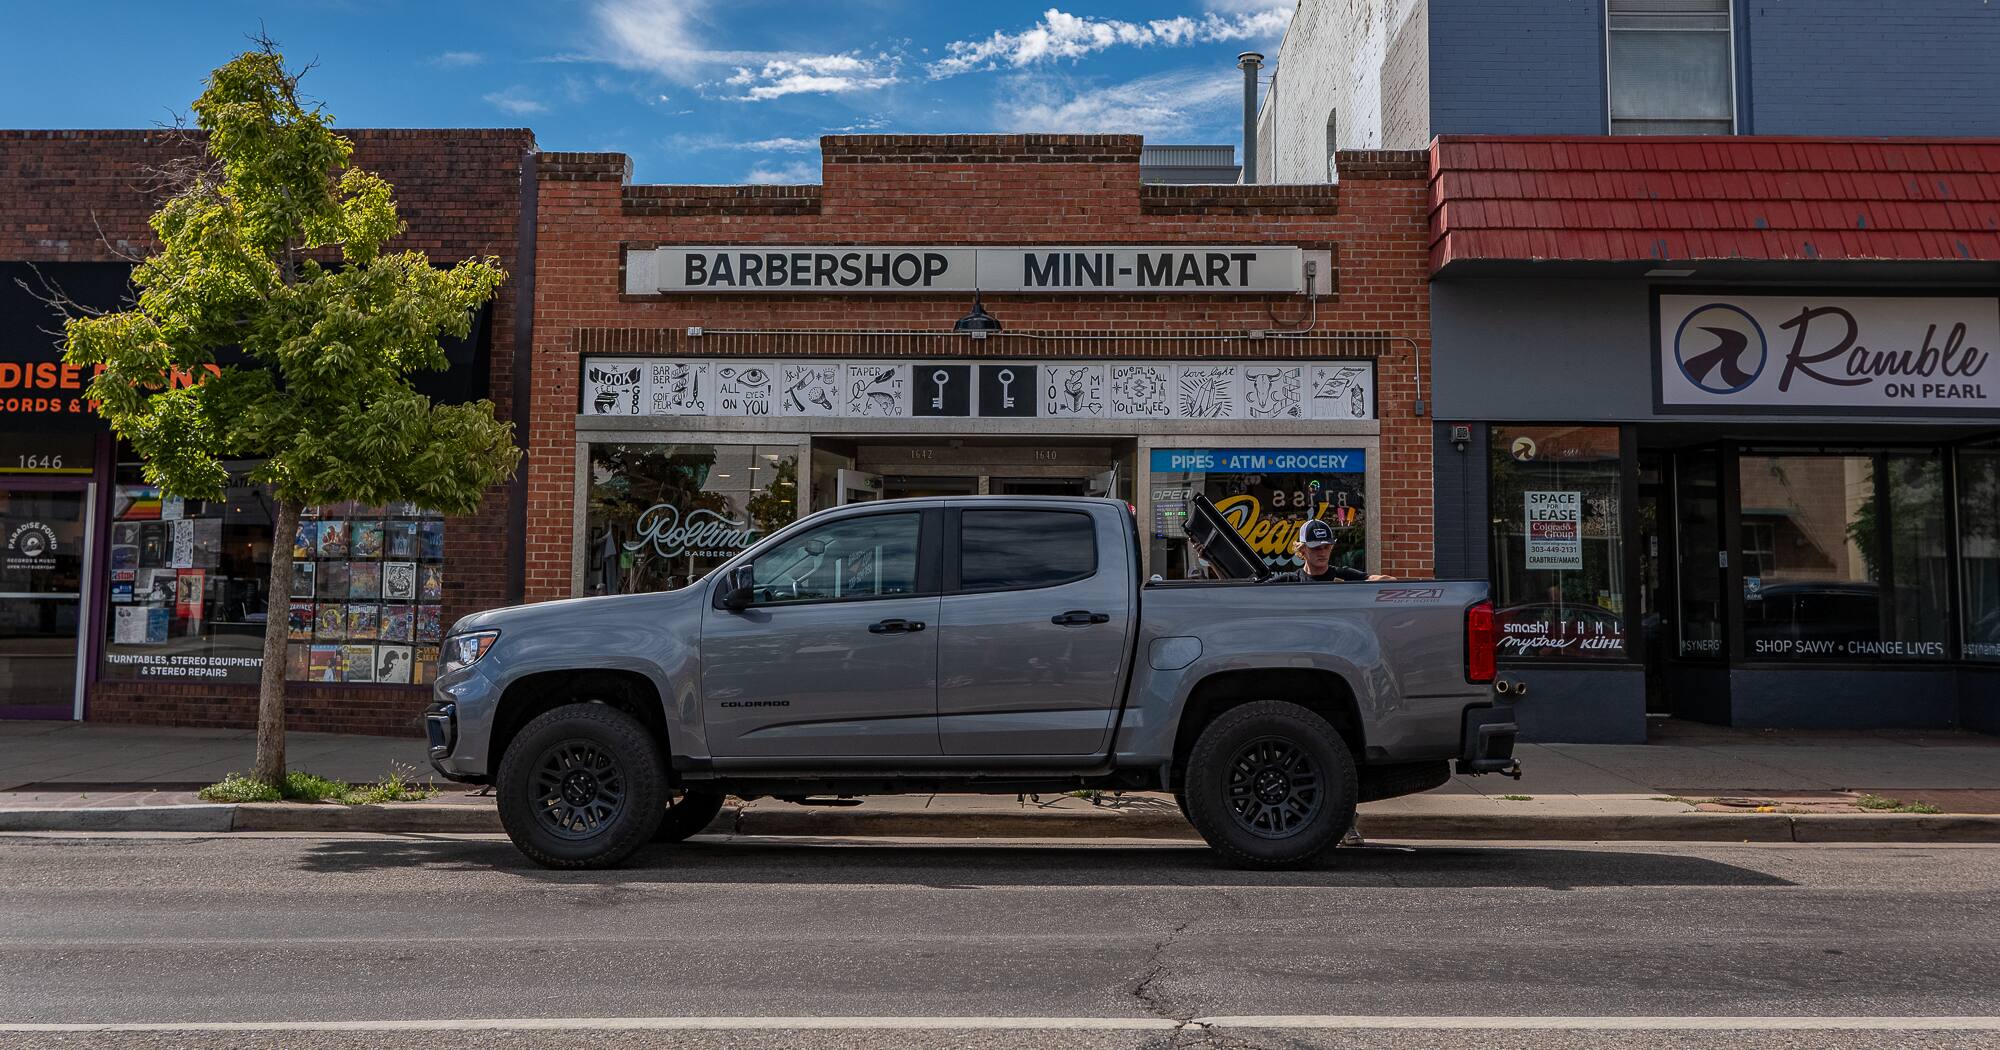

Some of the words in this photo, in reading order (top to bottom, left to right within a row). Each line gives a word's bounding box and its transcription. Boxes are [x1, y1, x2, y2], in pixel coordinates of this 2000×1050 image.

[685, 253, 949, 287] BARBERSHOP
[1024, 252, 1257, 287] MINI-MART
[1778, 306, 1989, 392] Ramble
[653, 366, 670, 376] BAR
[850, 367, 881, 377] TAPER
[599, 369, 631, 386] LOOK
[653, 376, 671, 385] BER
[1154, 374, 1167, 382] ALL
[720, 383, 740, 394] ALL
[892, 380, 903, 388] IT
[1885, 383, 1915, 398] ON
[1923, 383, 1987, 399] PEARL
[69, 400, 81, 412] &
[722, 399, 737, 409] ON
[743, 400, 769, 415] YOU
[1145, 401, 1170, 415] NEED
[19, 455, 62, 469] 1646
[1171, 455, 1215, 469] PIPES
[1230, 455, 1266, 469] ATM
[1275, 455, 1348, 469] GROCERY
[1152, 490, 1191, 500] OPEN
[1530, 494, 1575, 504] SPACE
[1530, 509, 1577, 520] LEASE
[623, 503, 756, 558] Rollins
[1532, 522, 1571, 531] Colorado
[8, 522, 40, 549] PARADISE
[41, 524, 57, 550] FOUND
[1544, 530, 1574, 539] Group
[1529, 556, 1580, 564] CRABTREE/AMARO
[1375, 589, 1446, 603] Z71
[1504, 621, 1549, 634] smash!
[1496, 635, 1577, 655] mystree
[1580, 636, 1623, 649] KÜHL
[1755, 640, 1793, 653] SHOP
[1795, 640, 1835, 653] SAVVY
[1848, 641, 1904, 654] CHANGE
[1907, 642, 1944, 655] LIVES
[108, 654, 169, 666] TURNTABLES,
[171, 656, 207, 665] STEREO
[209, 657, 263, 667] EQUIPMENT
[142, 667, 148, 675] &
[150, 667, 186, 675] STEREO
[188, 668, 228, 677] REPAIRS
[721, 700, 790, 708] COLORADO
